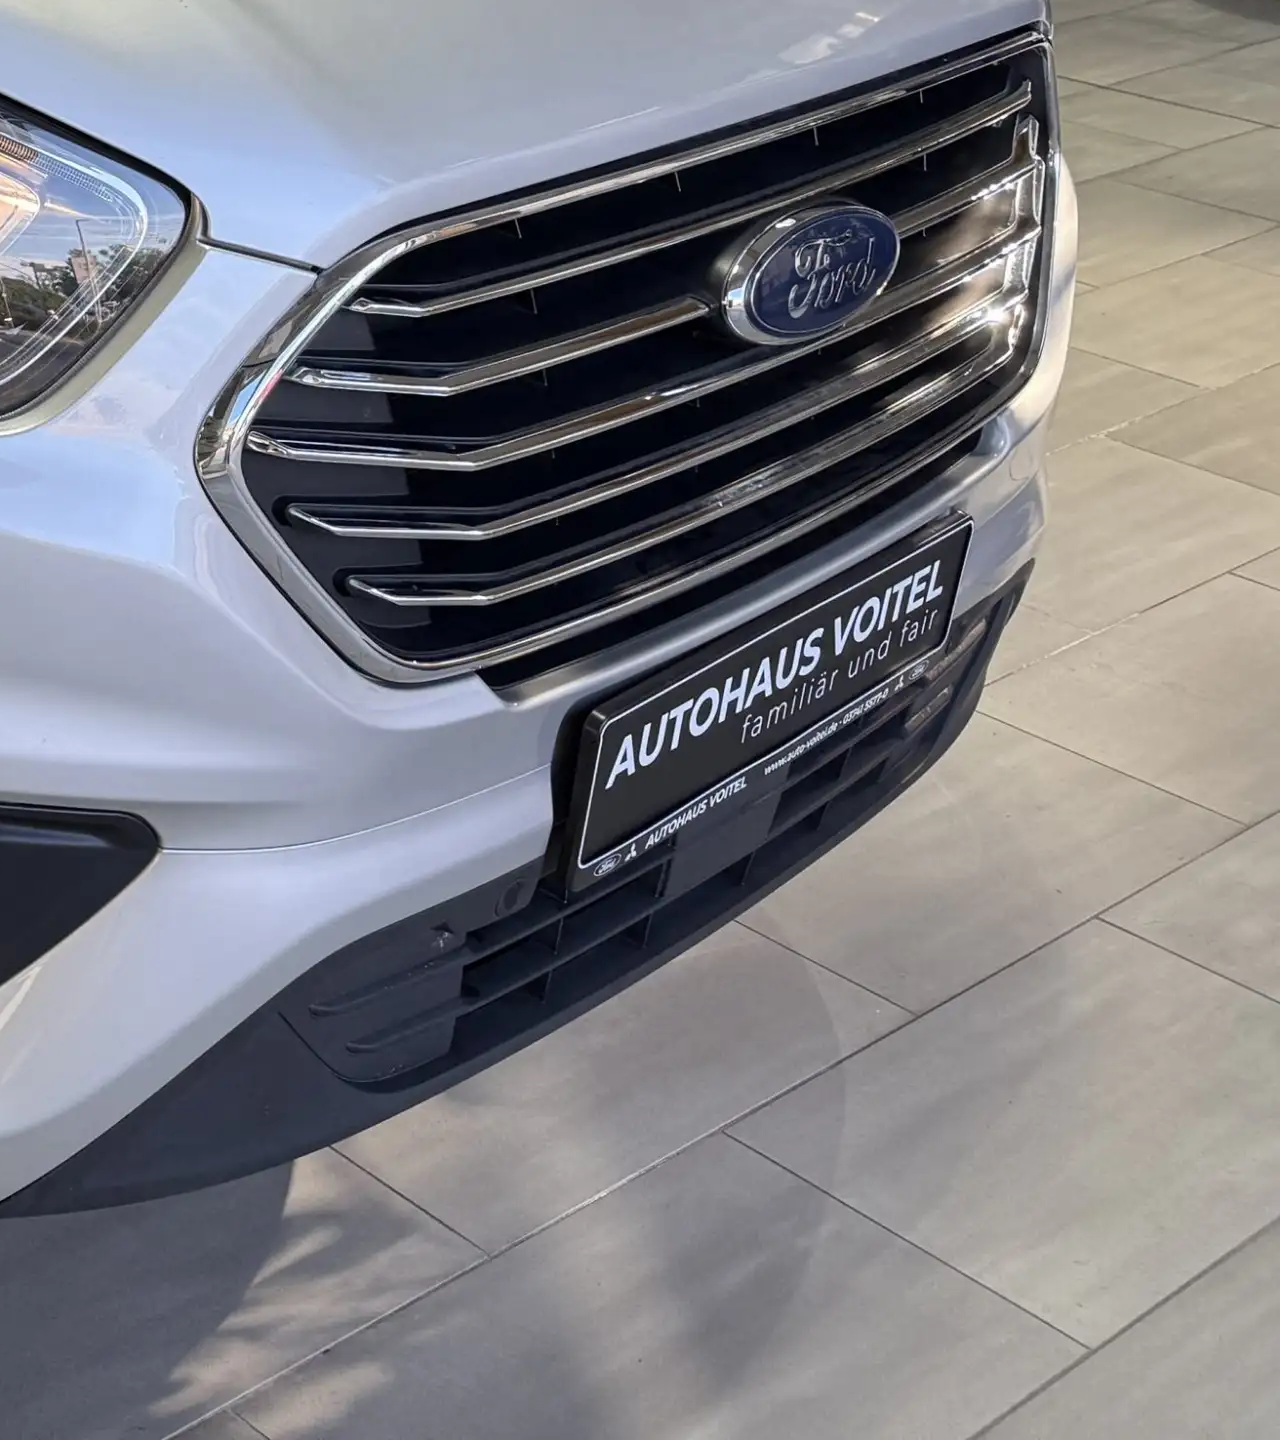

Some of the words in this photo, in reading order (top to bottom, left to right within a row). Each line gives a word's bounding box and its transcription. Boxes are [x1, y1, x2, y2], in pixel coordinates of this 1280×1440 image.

[788, 229, 875, 318] Ford
[605, 628, 824, 789] AUTOHAUS
[833, 560, 944, 656] VOITEL
[741, 668, 839, 744] familiär
[848, 637, 890, 680] und
[900, 606, 940, 661] fair
[645, 799, 708, 850] AUTOHAUS
[710, 776, 747, 808] VOITEL
